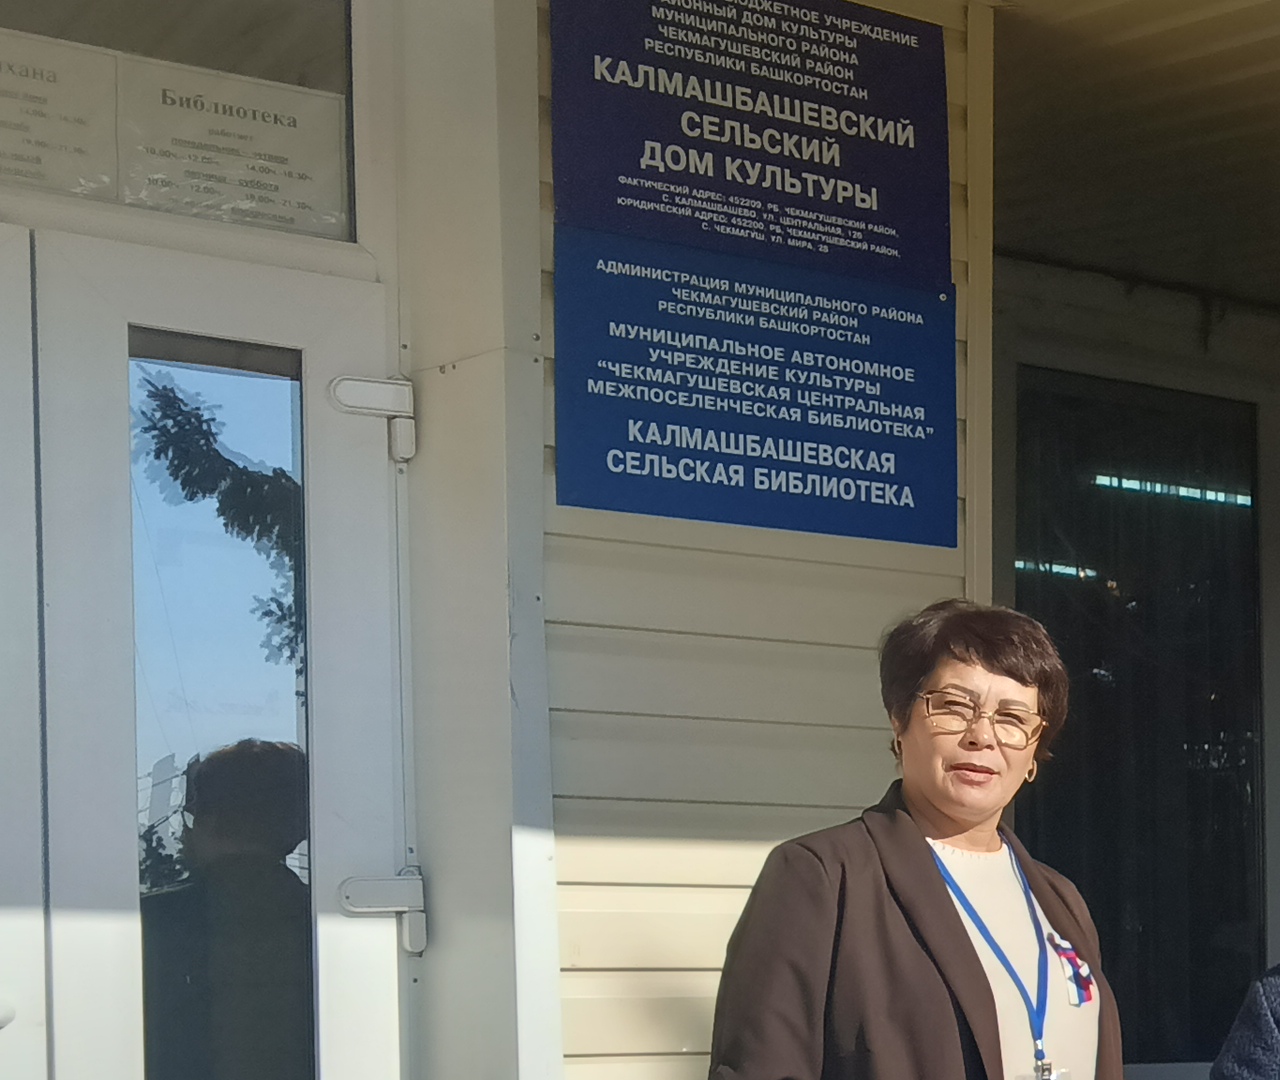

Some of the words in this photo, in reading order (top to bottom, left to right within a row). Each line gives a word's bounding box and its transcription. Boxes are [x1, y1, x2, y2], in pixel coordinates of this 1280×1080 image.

[651, 5, 797, 51] МУНИЦИПАЛЬНОГО
[801, 40, 859, 65] РАЙОНА
[725, 0, 820, 25] ДЖЕТНОЕ
[824, 14, 919, 48] УЧРЕЖДЕНИЕ
[741, 11, 776, 30] ДОМ
[781, 20, 857, 49] КУЛЬТУРЫ
[0, 61, 57, 84] хана
[644, 38, 746, 73] РЕСПУБЛИКИ
[750, 62, 868, 100] БАШКОРТОСТАН
[658, 24, 801, 68] ЧЕКМАГУШЕВСКИЙ
[806, 56, 854, 81] РАЙОН
[161, 88, 297, 129] Библиотека
[594, 55, 915, 149] КАЛМАШБАШЕВСКИЙ
[681, 110, 841, 167] СЕЛЬСКИЙ
[618, 175, 689, 195] ФАКТИЧЕСКИЙ
[692, 188, 726, 202] АДРЕС:
[784, 206, 866, 231] ЧЕКМАГУШЕВСКИЙ
[640, 140, 714, 178] ДОМ
[725, 156, 879, 211] КУЛЬТУРЫ
[617, 196, 692, 217] ЮРИДИЧЕСКИЙ
[694, 211, 728, 224] АДРЕС:
[786, 227, 869, 251] ЧЕКМАГУШЕВСКИЙ
[596, 258, 730, 293] АДМИНИСТРАЦИЯ
[734, 280, 867, 316] МУНИЦИПАЛЬНОГО
[872, 302, 924, 326] РАЙОНА
[671, 286, 808, 320] ЧЕКМАГУШЕВСКИЙ
[812, 307, 859, 329] РАЙОН
[658, 300, 755, 326] РЕСПУБЛИКИ
[759, 315, 871, 346] БАШКОРТОСТАН
[608, 321, 785, 363] МУНИЦИПАЛЬНОЕ
[791, 348, 915, 383] АВТОНОМНОЕ
[648, 347, 780, 381] УЧРЕЖДЕНИЕ
[785, 367, 881, 396] КУЛЬТУРЫ
[587, 378, 802, 423] МЕЖПОСЕЛЕНЧЕСКАЯ
[797, 389, 925, 422] ЦЕНТРАЛЬНАЯ
[627, 418, 896, 475] КАЛМАШБАШЕВСКАЯ
[606, 449, 745, 488] СЕЛЬСКАЯ
[754, 466, 915, 509] БИБЛИОТЕКА
